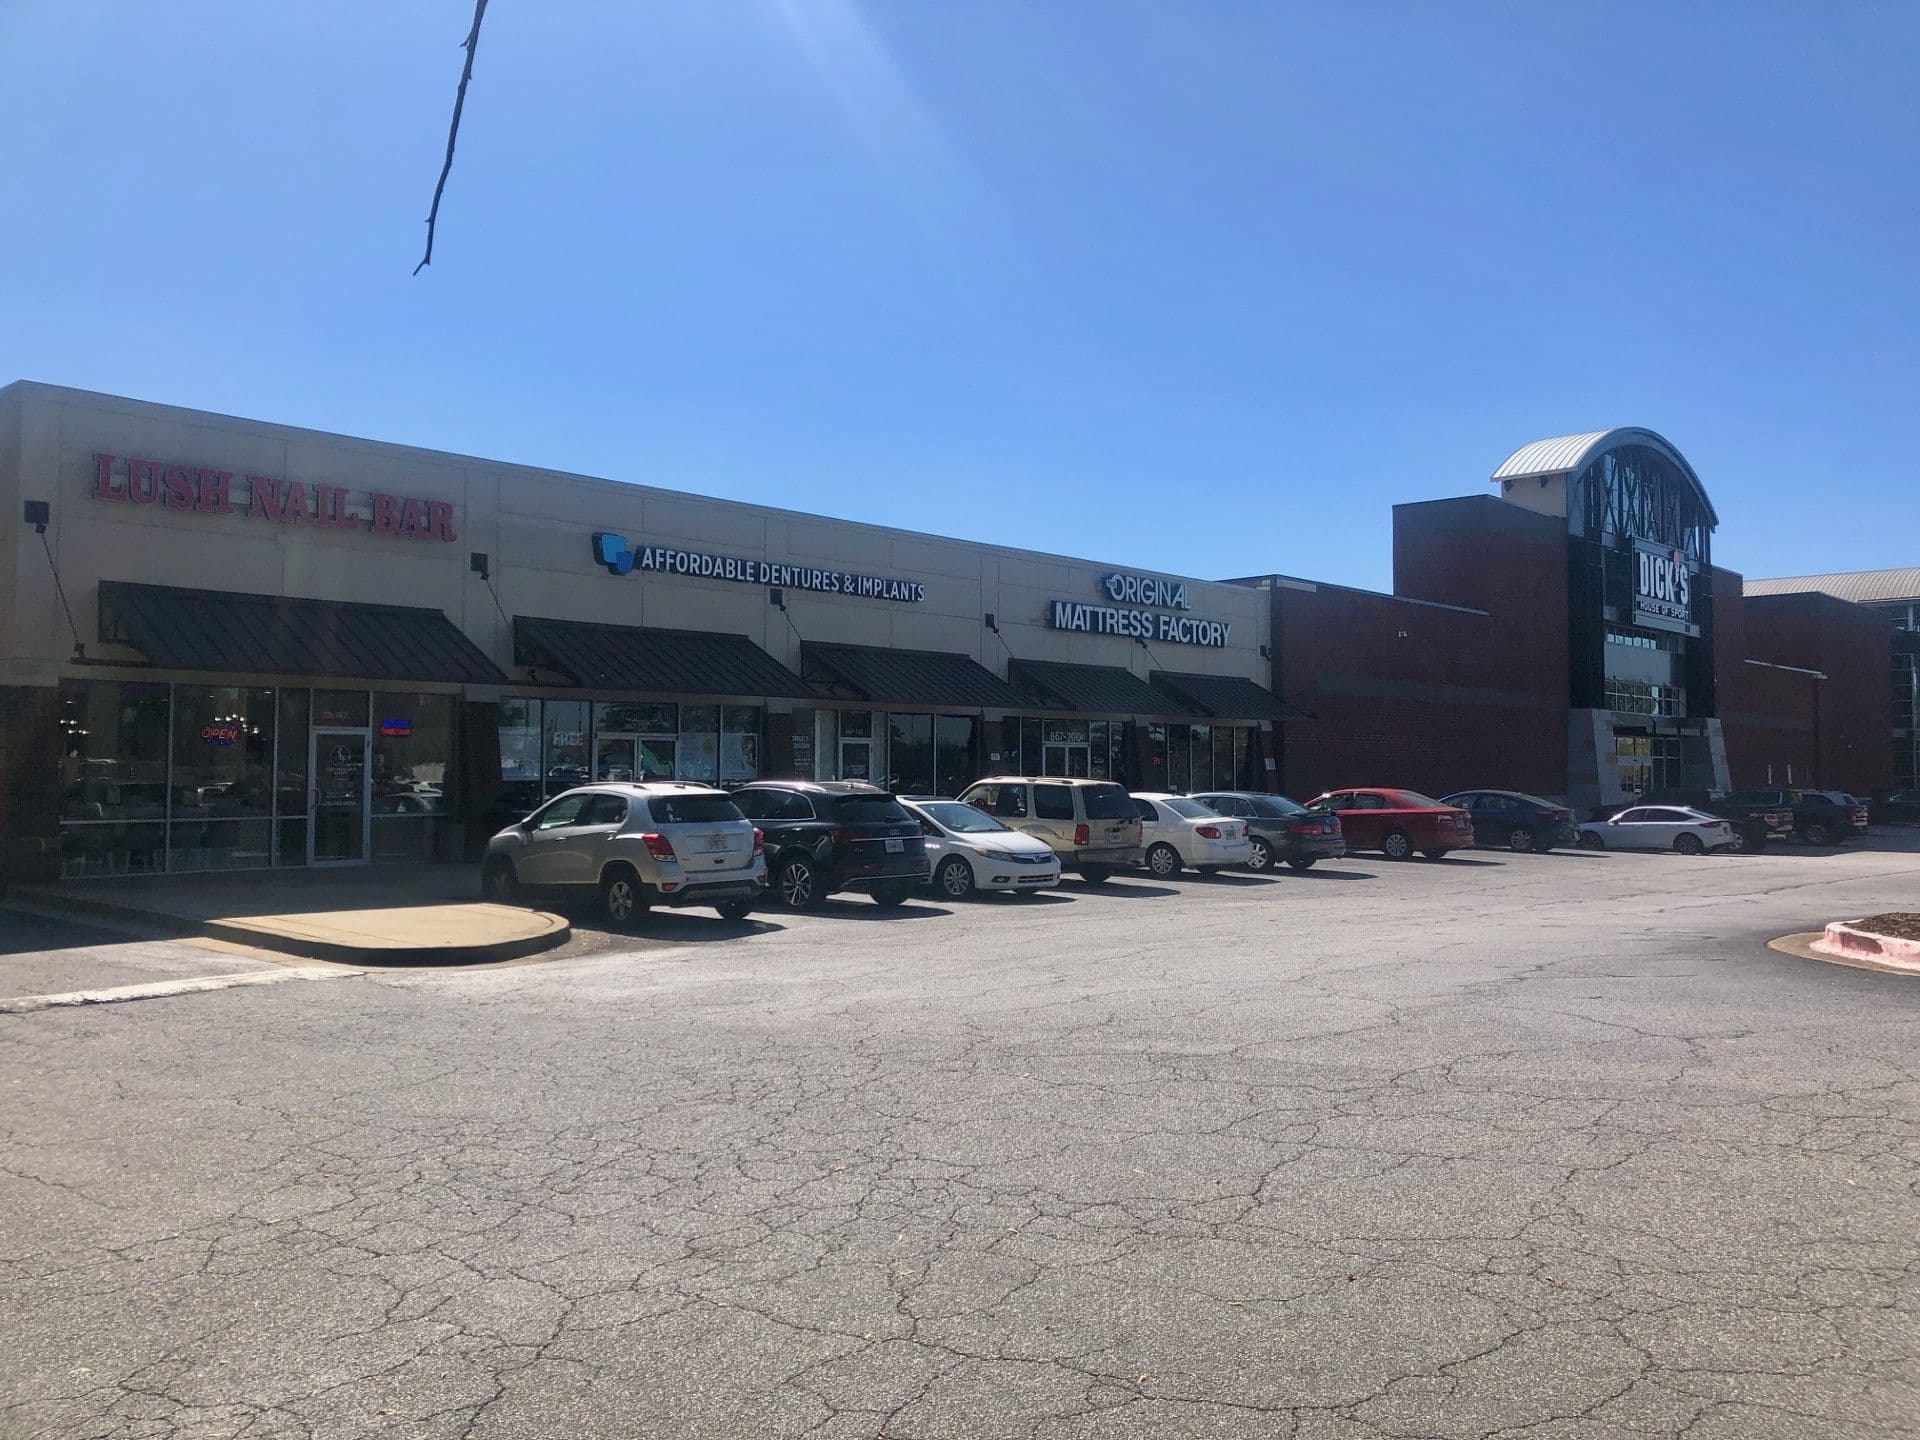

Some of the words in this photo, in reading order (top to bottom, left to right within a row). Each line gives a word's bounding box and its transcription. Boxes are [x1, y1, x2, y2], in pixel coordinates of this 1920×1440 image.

[93, 454, 233, 514] LUSH
[247, 474, 358, 529] NAIL
[369, 493, 458, 543] BAR
[641, 547, 755, 581] AFFORDABLE
[759, 563, 840, 591] DENTURES
[844, 574, 855, 593] &
[857, 576, 925, 602] IMPLANTS
[1110, 573, 1191, 609] ORIGINAL
[1640, 551, 1689, 604] DICK'S
[1055, 602, 1153, 638] MATTRESS
[1159, 615, 1232, 647] FACTORY
[1640, 601, 1659, 614] HOUSE
[1661, 606, 1669, 616] OF
[1670, 607, 1689, 620] SPORT
[202, 728, 238, 741] OPEN
[553, 731, 584, 746] FREE
